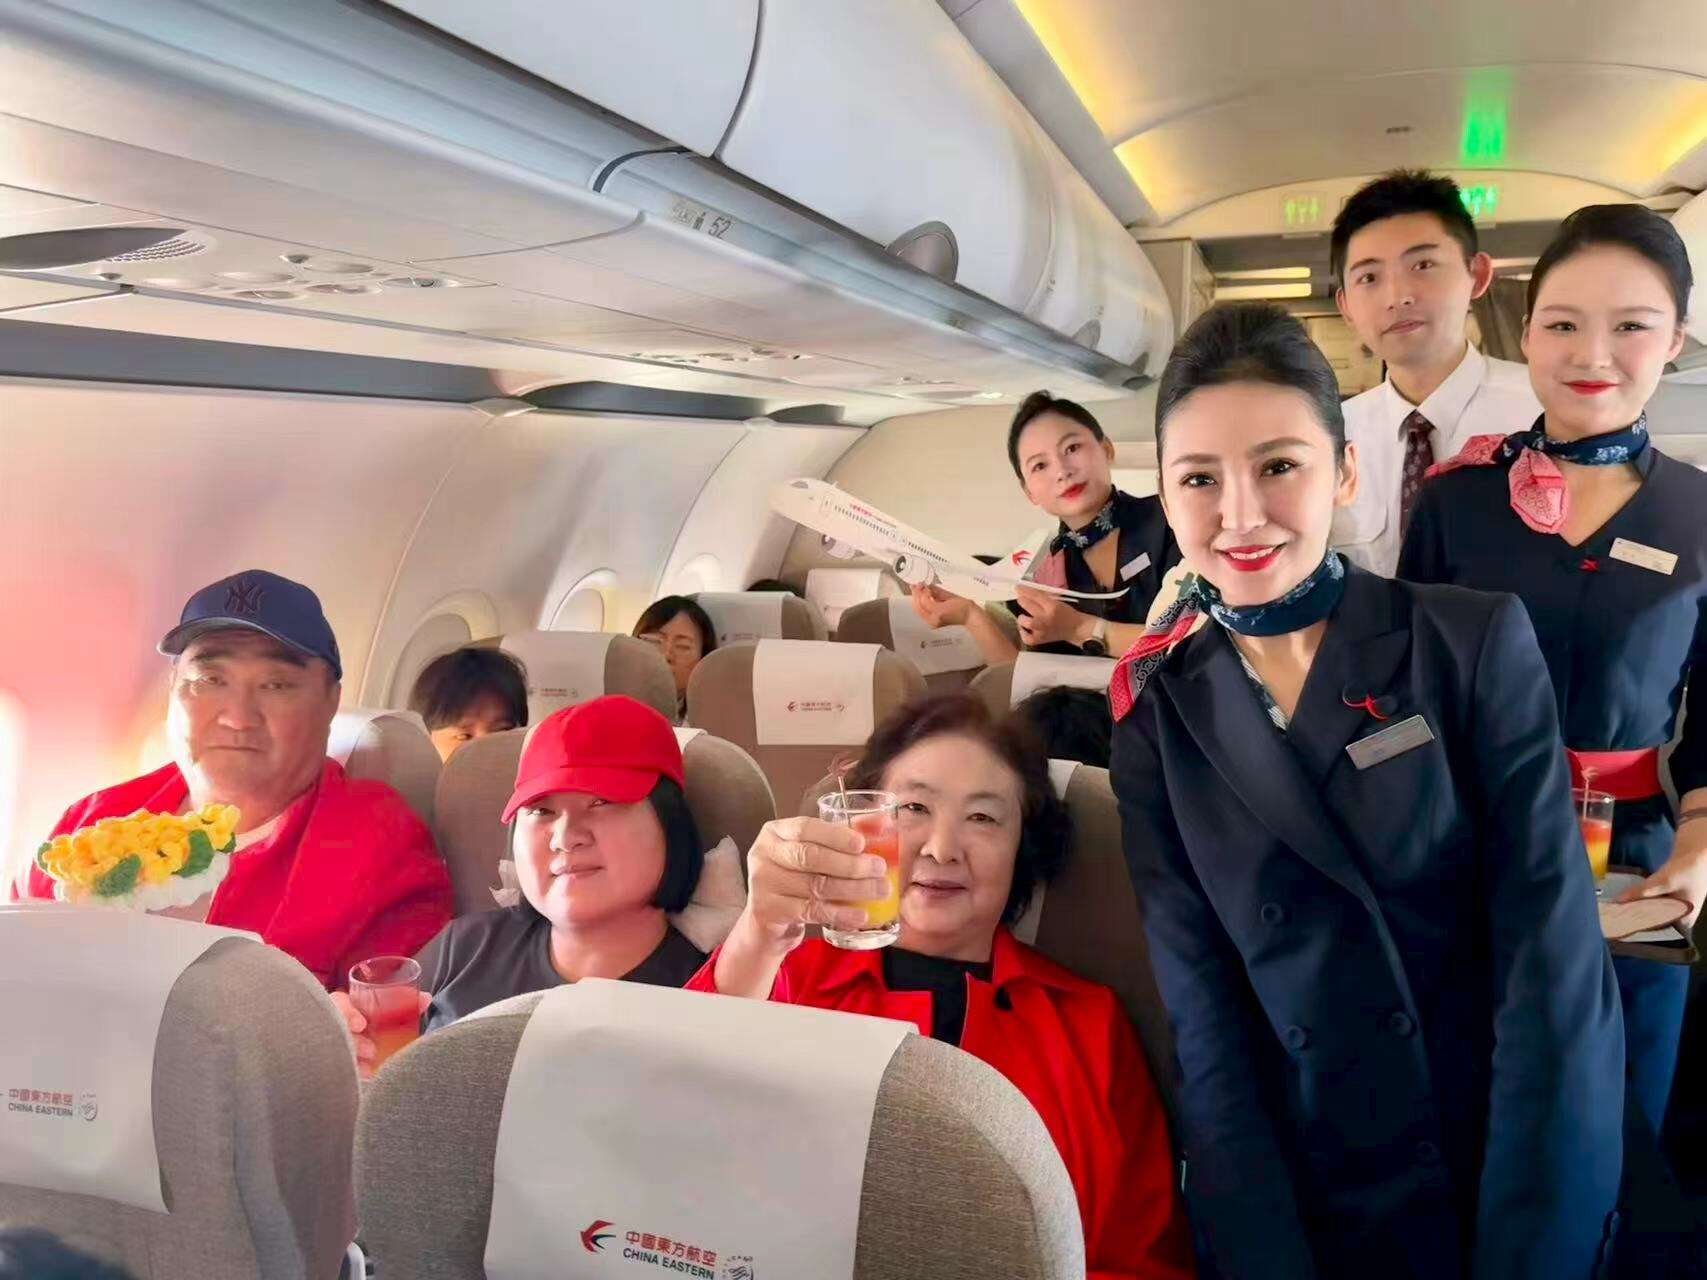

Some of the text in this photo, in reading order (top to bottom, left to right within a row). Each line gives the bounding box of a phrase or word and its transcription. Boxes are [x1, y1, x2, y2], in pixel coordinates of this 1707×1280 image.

[708, 216, 732, 240] 52
[8, 1103, 73, 1116] CHINA EASTERN
[625, 1231, 717, 1267] 中國東方航空
[623, 1248, 659, 1265] CHINA
[661, 1257, 715, 1280] EASTERN
